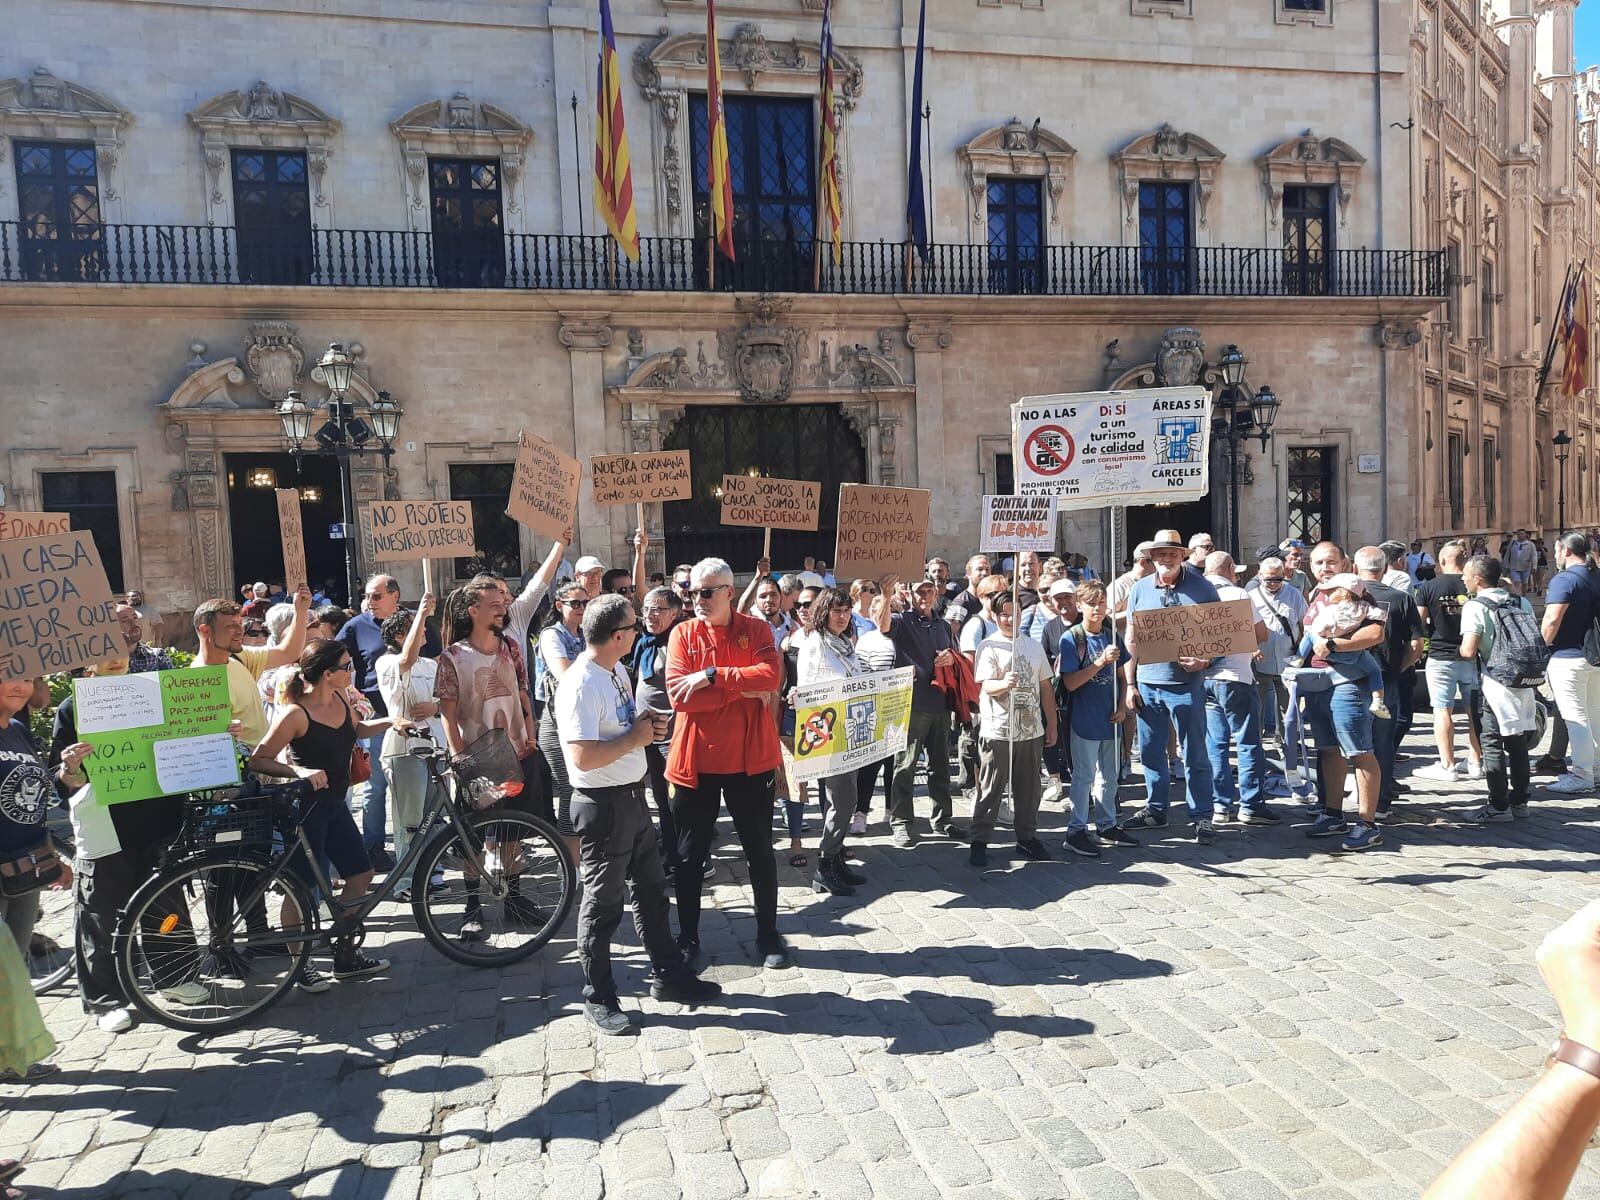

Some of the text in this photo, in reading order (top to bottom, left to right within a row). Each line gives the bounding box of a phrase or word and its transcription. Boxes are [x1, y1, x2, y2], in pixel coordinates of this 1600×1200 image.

[1100, 401, 1126, 417] Di SÍ
[1152, 397, 1205, 411] ÁREAS SÍ
[1020, 408, 1077, 421] NO A LAS
[1090, 430, 1136, 442] turismo
[1082, 440, 1144, 455] de calidad
[594, 456, 685, 474] NUESTRA CARAVANA
[1098, 454, 1146, 464] consumismo
[594, 470, 688, 488] ES IGUAL DE DIGNA
[1152, 467, 1202, 478] CÁRCELES
[726, 479, 746, 492] NO
[754, 480, 794, 498] SOMOS
[1021, 478, 1080, 488] PROHIBICIONES
[1168, 478, 1184, 487] NO
[596, 486, 679, 502] COMO SU CASA
[723, 493, 816, 510] CAUSA SOMOS LA
[845, 491, 909, 507] LA NUEVA
[991, 498, 1050, 508] CONTRA UNA
[373, 502, 467, 527] NO PISOTEIS
[730, 508, 811, 524] CONSECUENCIA
[840, 509, 914, 526] ORDENANZA
[993, 510, 1048, 521] ORDENANZA
[839, 529, 924, 544] NO COMPRENDE
[991, 522, 1048, 538] ILEGAL
[374, 526, 475, 553] NUESTROS DERECHOS
[23, 540, 92, 574] CASA
[839, 549, 852, 560] MI
[78, 601, 118, 627] QUE
[1136, 606, 1232, 630] LIBERTAD SOBRE
[1137, 628, 1174, 644] RUEDAS
[1200, 620, 1252, 640] PREFIERES
[1178, 638, 1232, 658] ATASCOS?
[162, 675, 222, 690] QUEREMOS
[77, 684, 136, 698] NUESTRAS
[172, 692, 211, 703] VIVIR EN
[170, 708, 190, 716] PAZ
[178, 727, 200, 735] FUERA
[88, 741, 134, 760] NO A
[90, 765, 108, 776] LA
[106, 778, 136, 792] LEY
